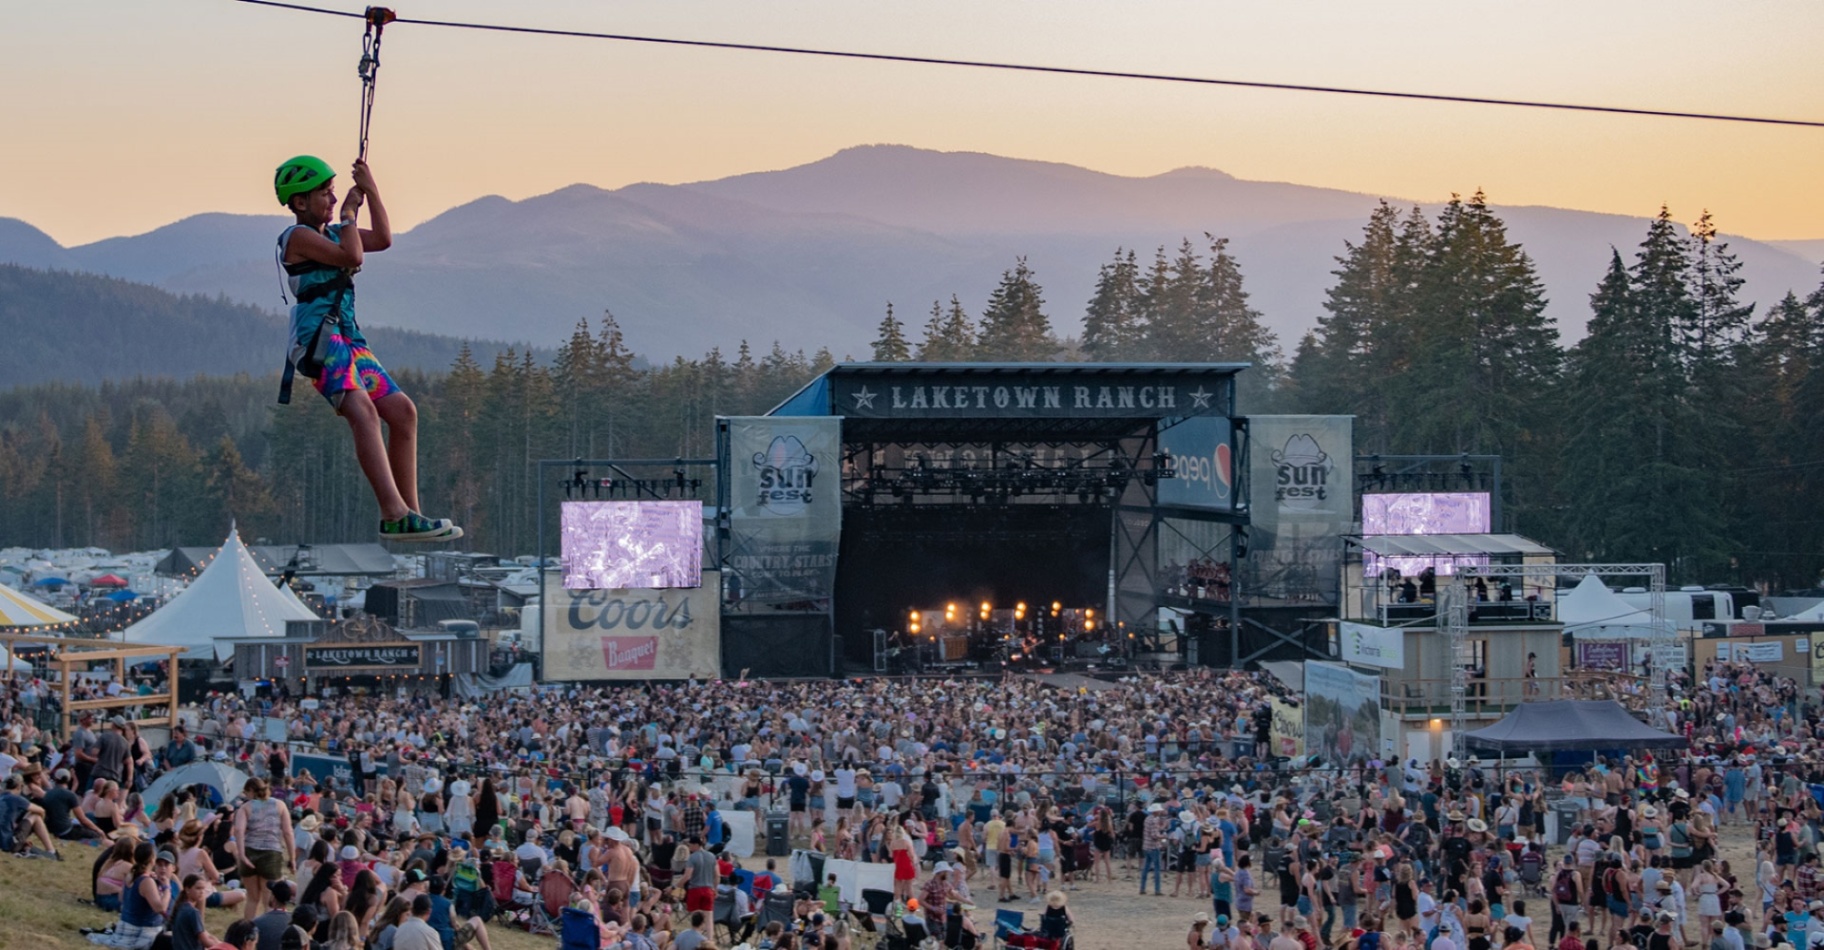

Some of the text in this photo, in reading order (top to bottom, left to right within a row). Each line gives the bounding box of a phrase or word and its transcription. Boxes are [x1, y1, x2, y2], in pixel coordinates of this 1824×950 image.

[891, 386, 1176, 409] LAKETOWN RANCH
[1277, 466, 1327, 486] sun
[756, 489, 813, 506] fest
[1274, 486, 1327, 502] fest
[734, 554, 833, 569] COUNTRY STARS
[567, 588, 694, 630] Coors
[315, 648, 408, 662] LAKETOWN RANCH
[608, 640, 655, 668] Banquet
